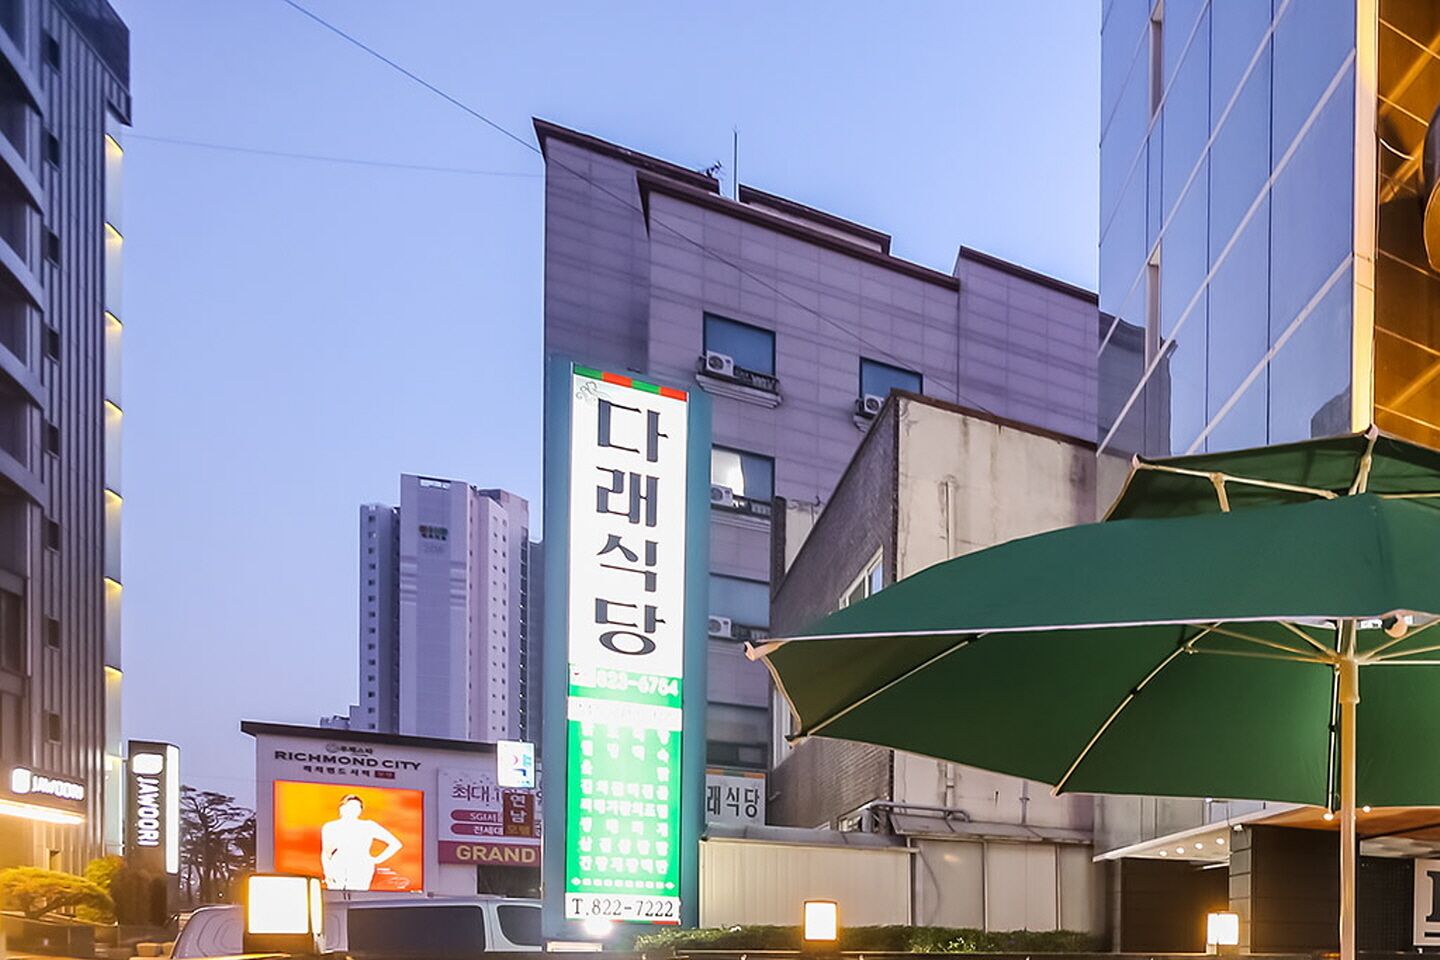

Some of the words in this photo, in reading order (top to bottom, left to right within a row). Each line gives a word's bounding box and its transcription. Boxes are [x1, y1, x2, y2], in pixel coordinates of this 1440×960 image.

[594, 398, 669, 656] 다래식당
[274, 751, 378, 767] RICHMOND
[381, 760, 421, 770] CITY
[136, 776, 160, 847] JAWOORI
[456, 845, 536, 862] GRAND
[571, 898, 674, 917] T.822-7222
